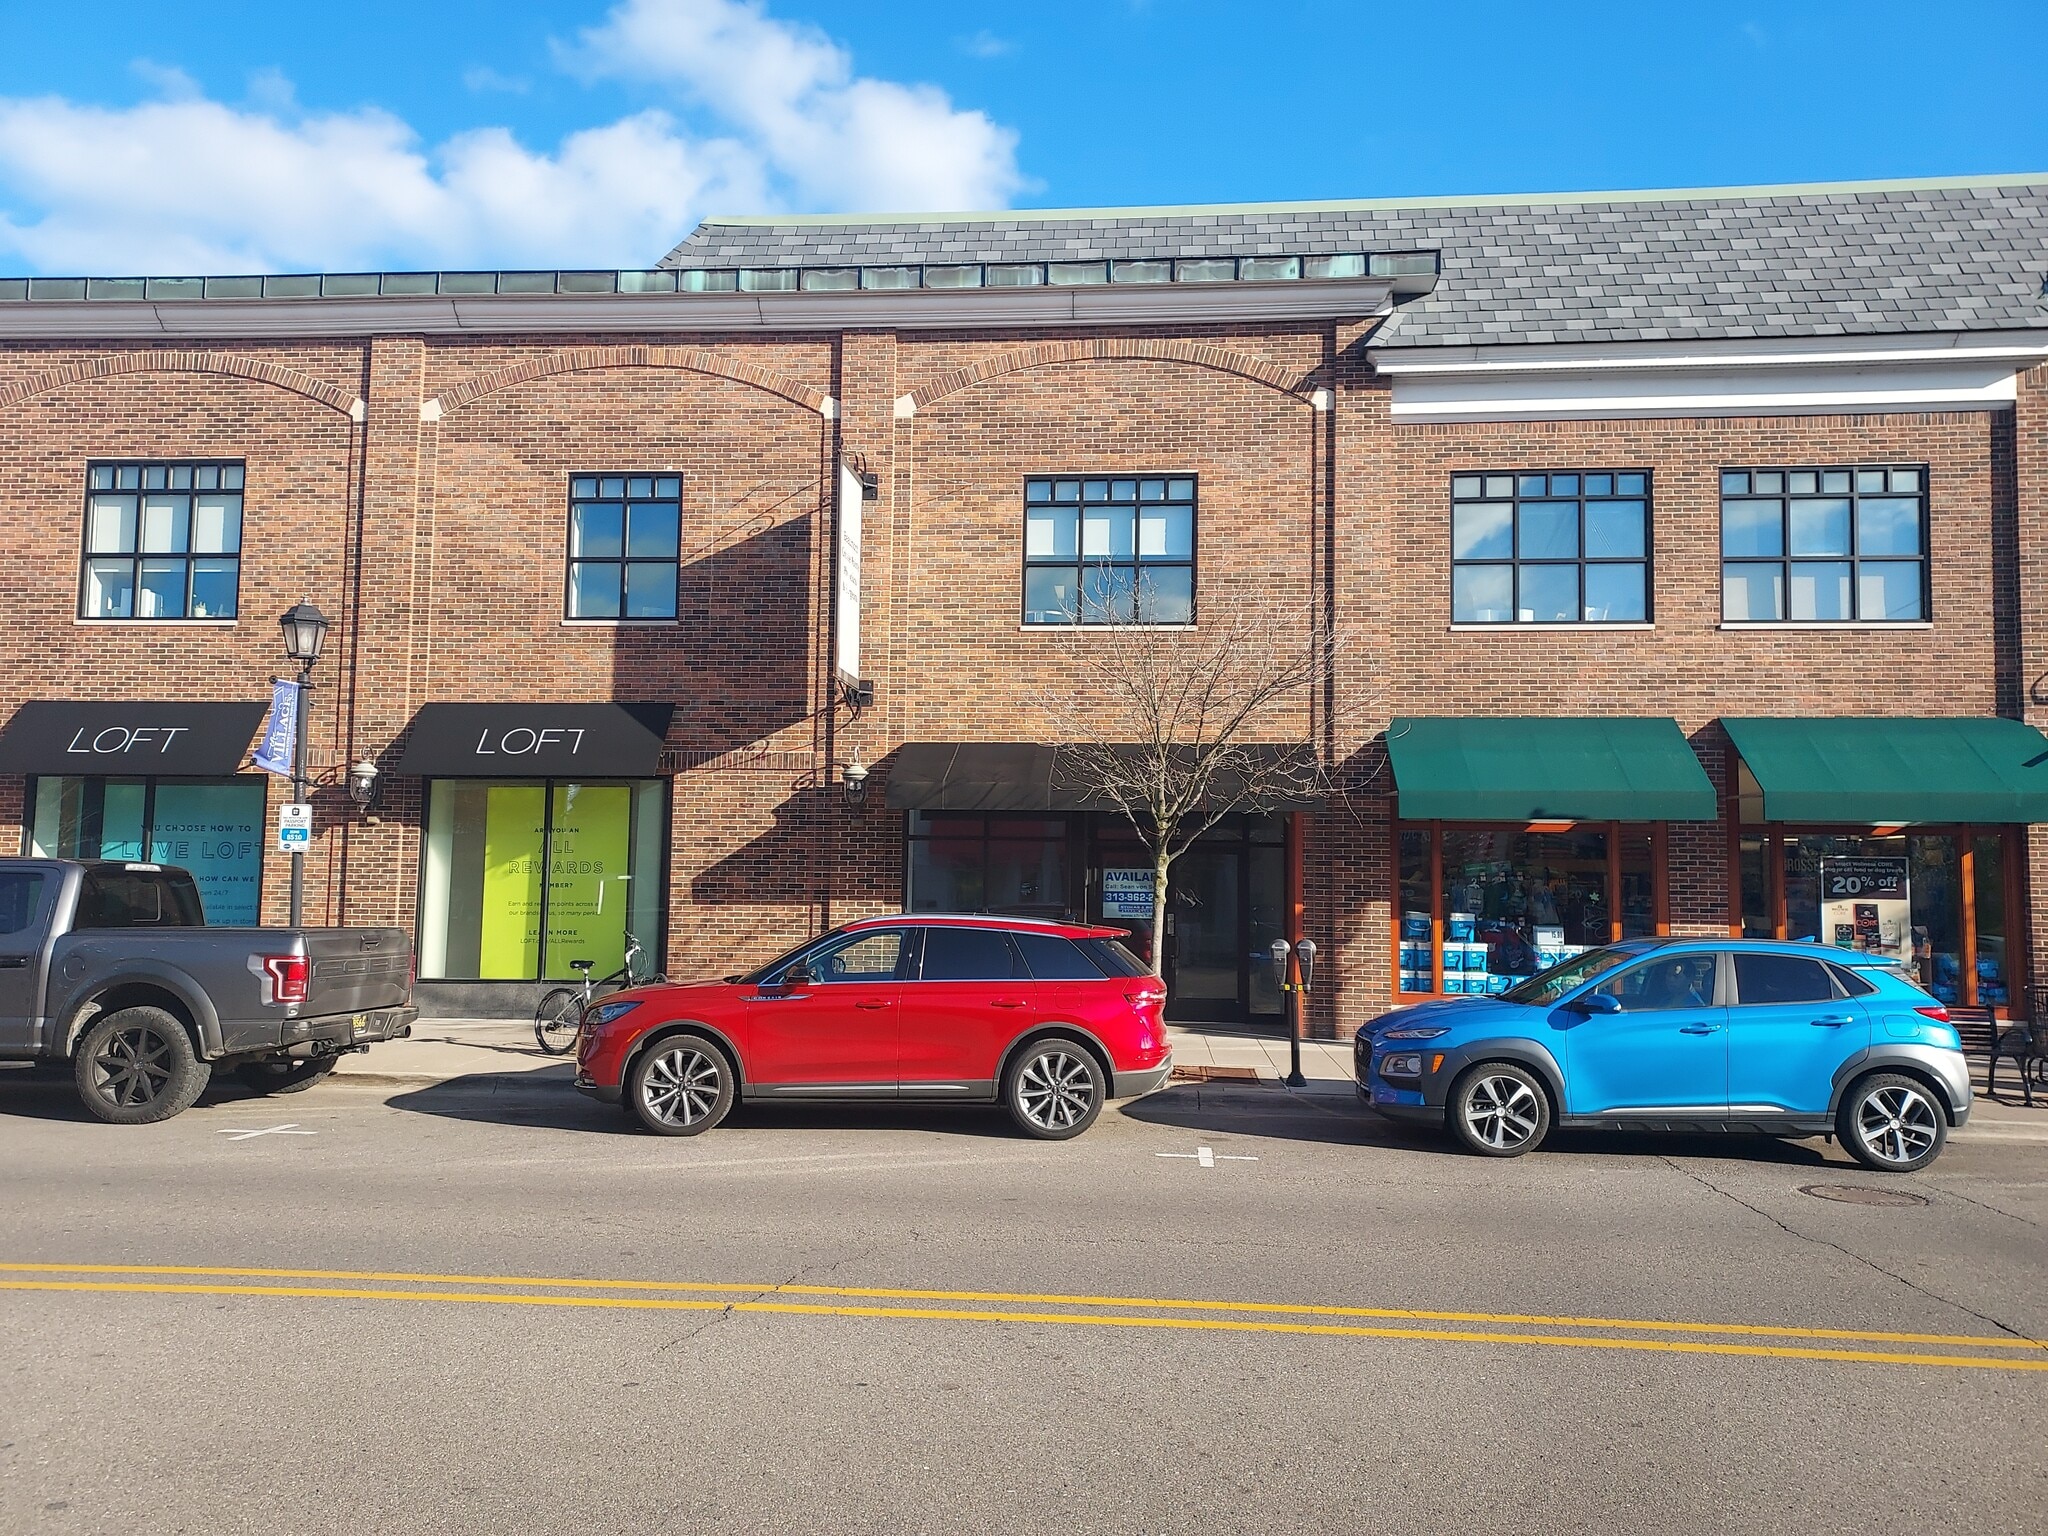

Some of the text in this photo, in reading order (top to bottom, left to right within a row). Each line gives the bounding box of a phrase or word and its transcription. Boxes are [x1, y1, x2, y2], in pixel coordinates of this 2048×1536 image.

[67, 727, 189, 753] LOFT
[476, 728, 585, 754] LOFT
[165, 824, 206, 832] CHOOSE
[1832, 876, 1898, 893] 20% off
